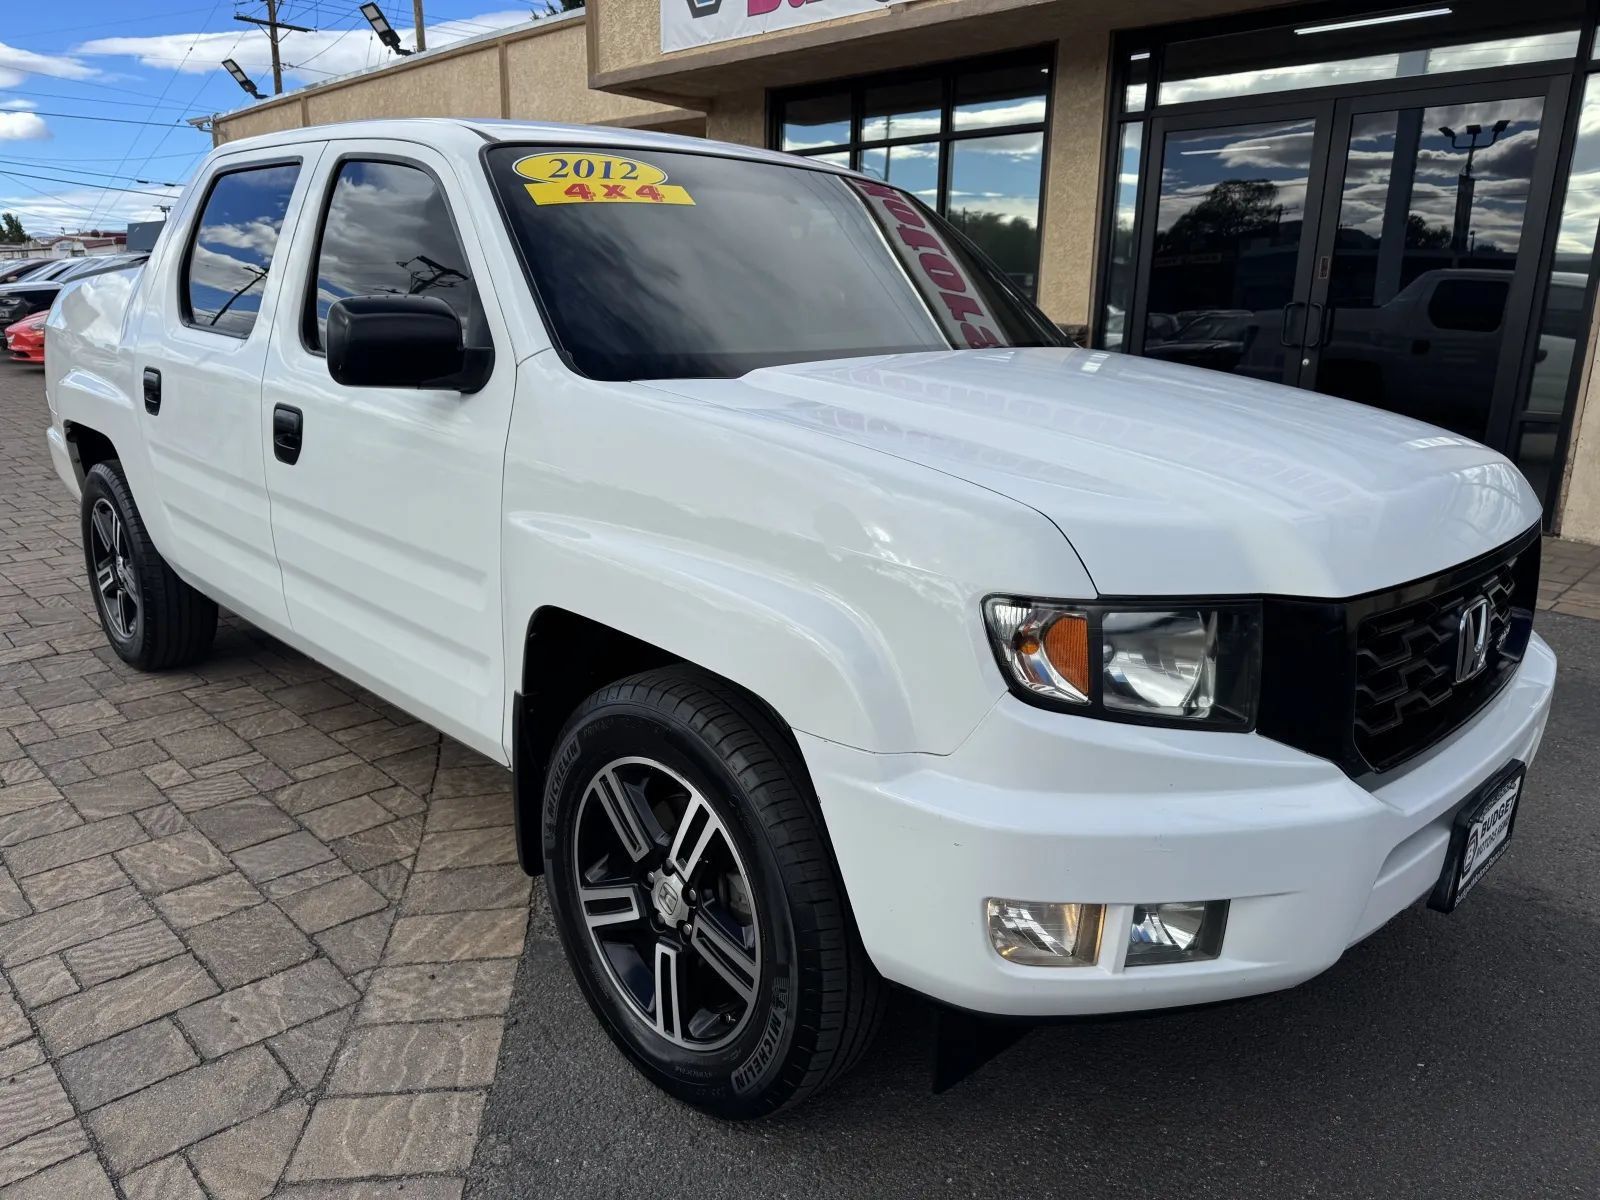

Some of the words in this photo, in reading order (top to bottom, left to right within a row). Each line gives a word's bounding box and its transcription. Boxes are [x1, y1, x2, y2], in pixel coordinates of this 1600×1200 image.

[548, 158, 639, 180] 2012
[546, 738, 579, 819] MICHELIN
[1480, 792, 1517, 839] BUDGET
[735, 1012, 783, 1089] MICHELIN
